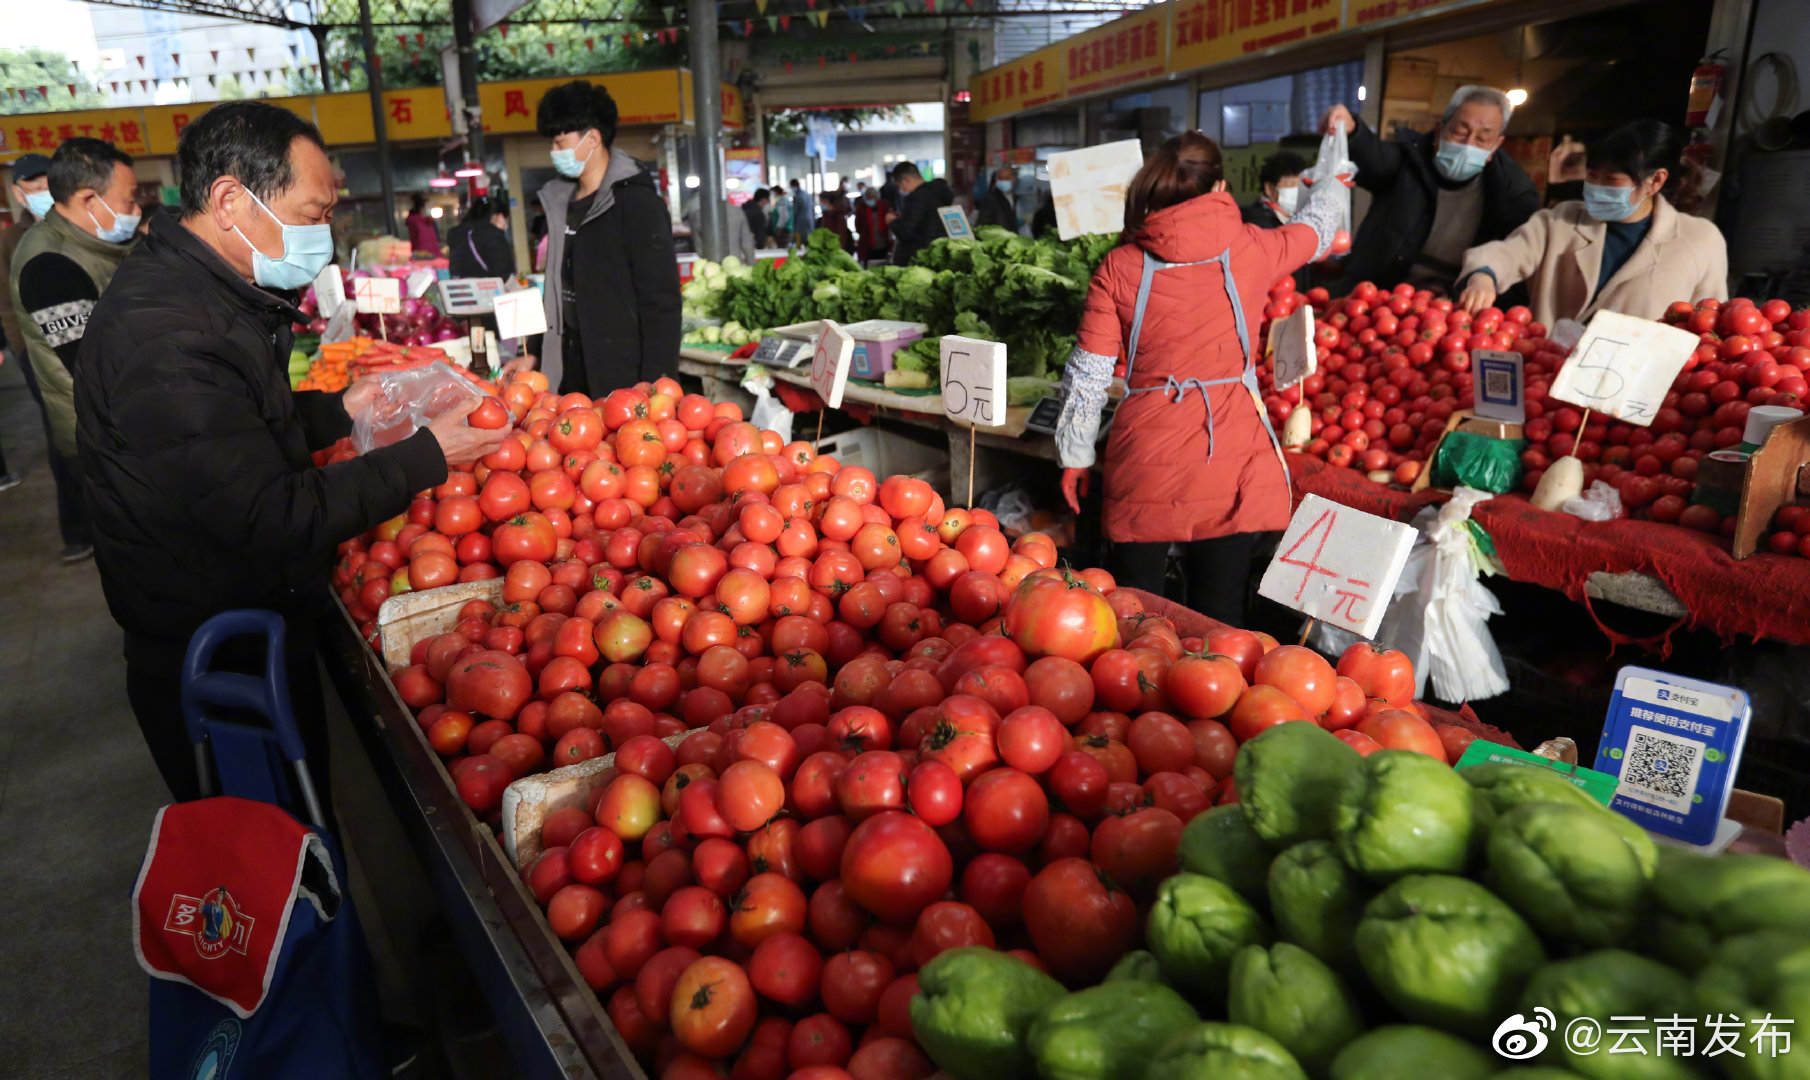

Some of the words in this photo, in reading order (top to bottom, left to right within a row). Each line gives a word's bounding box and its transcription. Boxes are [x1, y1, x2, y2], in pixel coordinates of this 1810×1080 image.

[389, 97, 412, 123] 石
[504, 89, 530, 117] 风
[15, 119, 141, 150] 东北手工水饺
[945, 350, 993, 422] 5元
[1573, 336, 1656, 420] 5元
[1279, 508, 1370, 623] 4元
[1670, 691, 1699, 708] 支付宝
[1629, 705, 1717, 738] 推荐使用支付宝
[174, 903, 197, 926] 多
[232, 920, 245, 945] 力
[197, 930, 224, 952] MIGHTY
